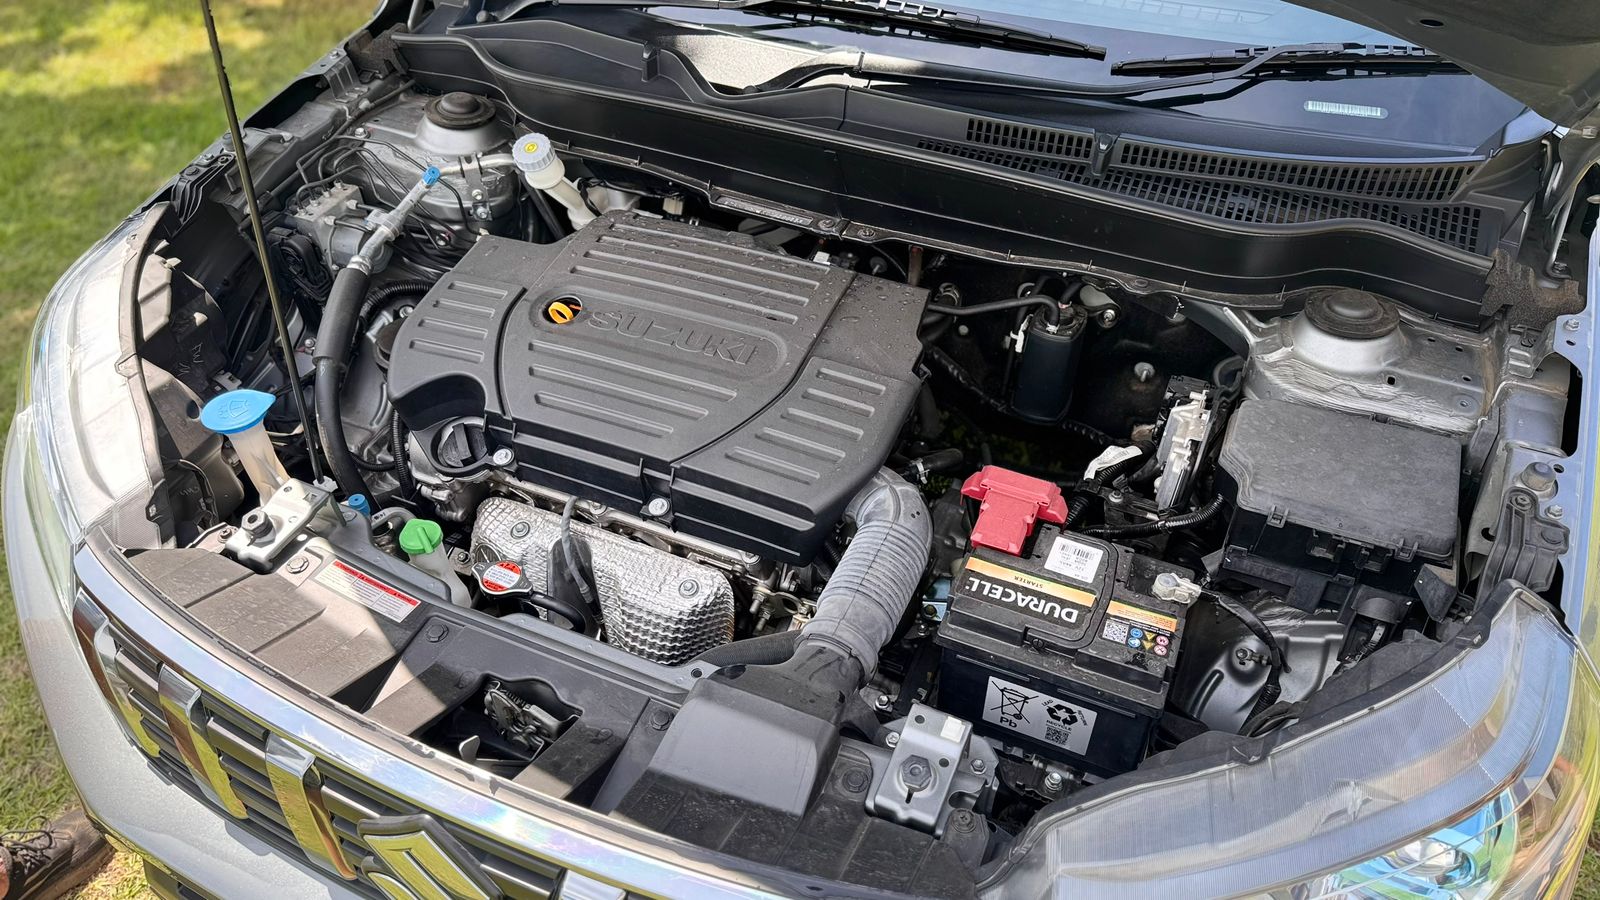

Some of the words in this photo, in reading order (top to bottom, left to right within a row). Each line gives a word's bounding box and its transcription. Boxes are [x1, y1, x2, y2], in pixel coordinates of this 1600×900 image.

[588, 311, 757, 365] SUZUKI
[1014, 575, 1044, 589] STARTER
[966, 576, 1079, 624] DURACELL
[1041, 699, 1054, 707] LEAD
[999, 716, 1018, 728] Pb
[1046, 719, 1073, 732] RECYCLE
